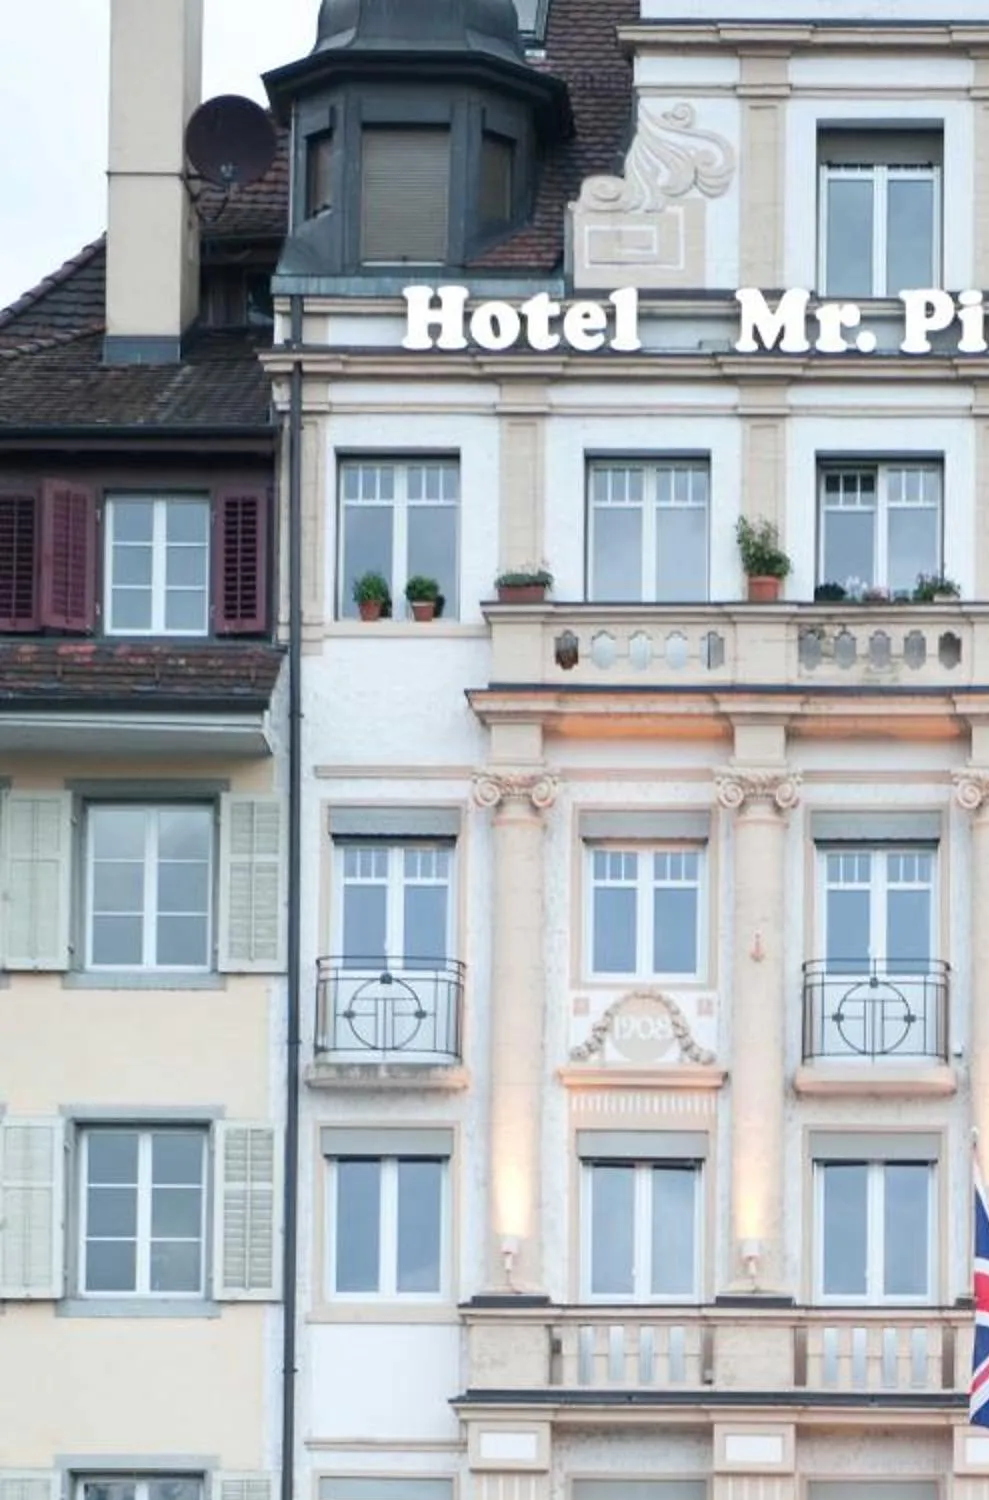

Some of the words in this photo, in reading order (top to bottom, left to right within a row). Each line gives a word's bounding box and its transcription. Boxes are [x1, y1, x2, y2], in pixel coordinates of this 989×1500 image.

[402, 285, 642, 352] Hotel
[734, 287, 877, 354] Mr.
[613, 1015, 671, 1040] 1908
